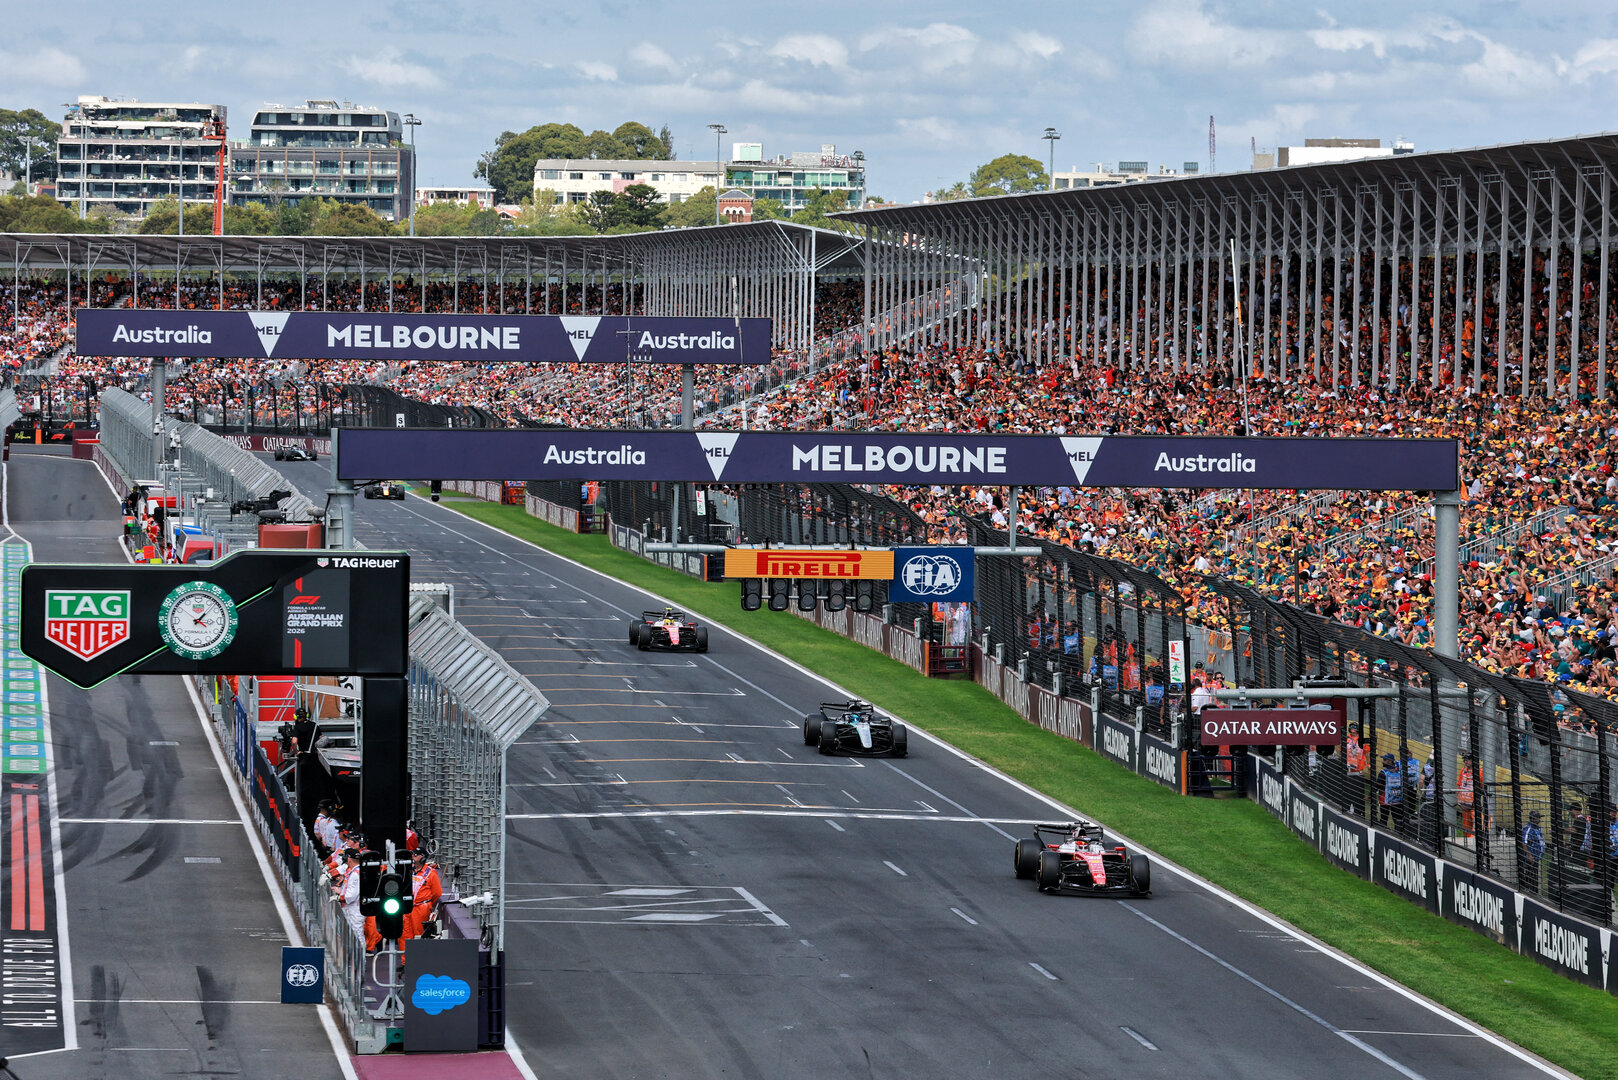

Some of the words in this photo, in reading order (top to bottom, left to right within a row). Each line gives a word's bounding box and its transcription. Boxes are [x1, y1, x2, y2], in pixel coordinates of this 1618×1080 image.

[112, 325, 212, 344] Australia
[256, 326, 281, 336] MEL
[327, 324, 521, 350] MELBOURNE
[567, 330, 593, 340] MEL
[638, 331, 735, 350] Australia
[543, 444, 646, 466] Australia
[704, 447, 730, 458] MEL
[792, 445, 1007, 474] MELBOURNE
[1068, 451, 1094, 462] MEL
[1153, 451, 1256, 473] Australia
[756, 551, 863, 577] PIRELLI
[53, 595, 122, 616] TAG
[50, 622, 125, 655] HEUER
[1038, 691, 1057, 733] QATAR
[1057, 698, 1083, 741] AIRWAYS
[1204, 720, 1262, 739] QATAR
[1265, 720, 1337, 737] AIRWAYS
[1103, 725, 1130, 763] MELBOURNE
[1145, 745, 1176, 785] MELBOURNE
[1327, 821, 1360, 868] MELBOURNE
[1383, 846, 1427, 899] MELBOURNE
[1453, 878, 1504, 935] MELBOURNE
[2, 938, 54, 954] FOR
[1534, 916, 1589, 975] MELBOURNE
[2, 959, 57, 988] DRIVE
[419, 988, 466, 999] salesforce
